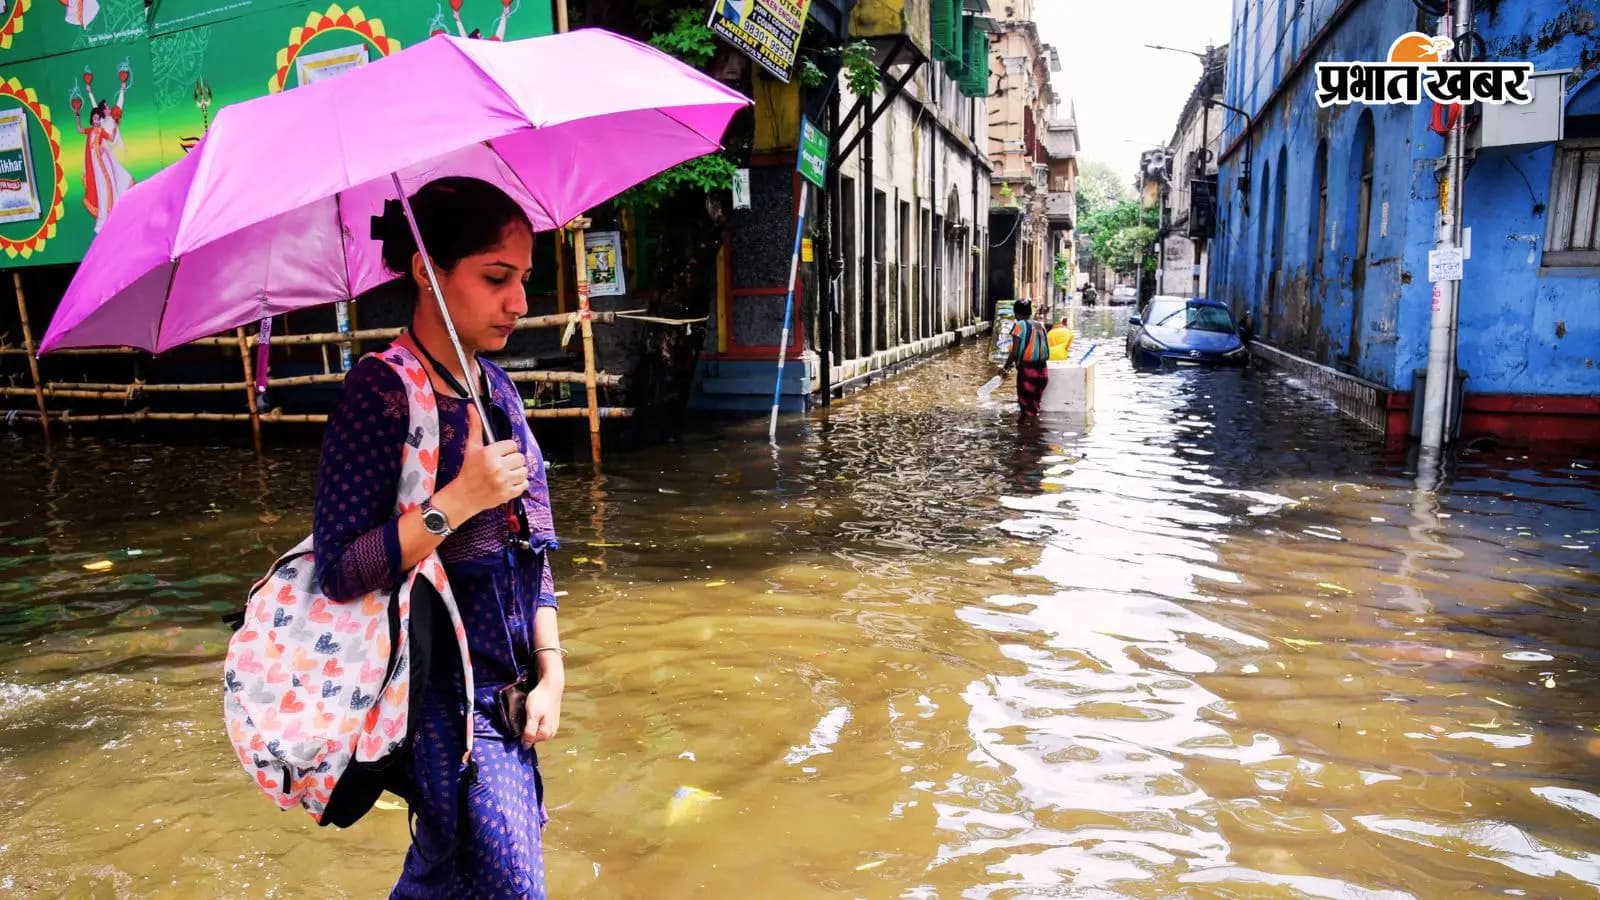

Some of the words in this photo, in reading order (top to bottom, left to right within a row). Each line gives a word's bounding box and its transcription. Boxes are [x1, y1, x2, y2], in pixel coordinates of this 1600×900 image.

[754, 4, 768, 17] JOIN
[771, 17, 792, 37] COURSE
[757, 15, 780, 38] COURSE
[779, 32, 793, 49] FREE
[719, 18, 759, 48] AMHERST
[760, 45, 789, 70] STREET
[744, 20, 769, 45] 98301
[770, 39, 793, 64] 99516
